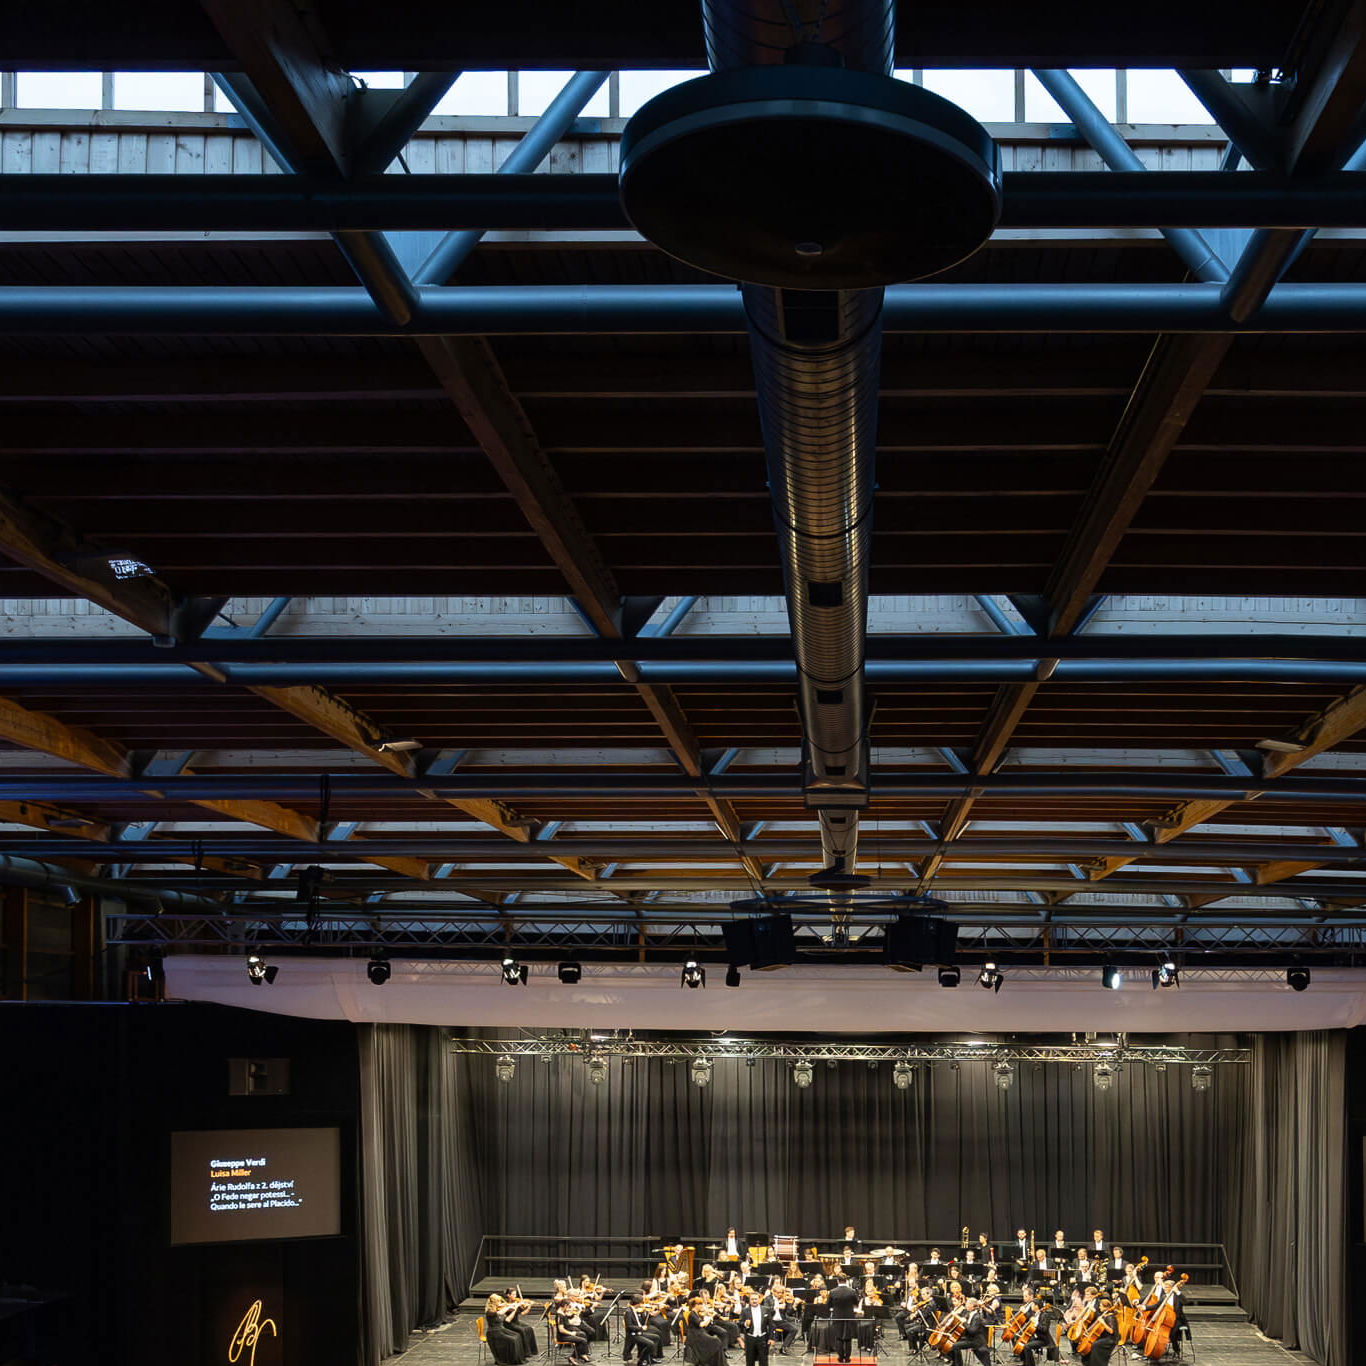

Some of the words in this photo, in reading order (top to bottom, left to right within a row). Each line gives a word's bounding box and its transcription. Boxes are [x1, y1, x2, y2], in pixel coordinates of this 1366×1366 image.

[210, 1159, 244, 1168] Giuseppe
[246, 1158, 266, 1167] Verdi
[211, 1170, 230, 1178] Luisa
[231, 1169, 251, 1177] Miller
[227, 1182, 255, 1191] Rudolfa
[262, 1182, 268, 1190] 2.
[222, 1192, 238, 1200] Fede
[210, 1202, 238, 1211] Quando
[263, 1200, 269, 1208] al
